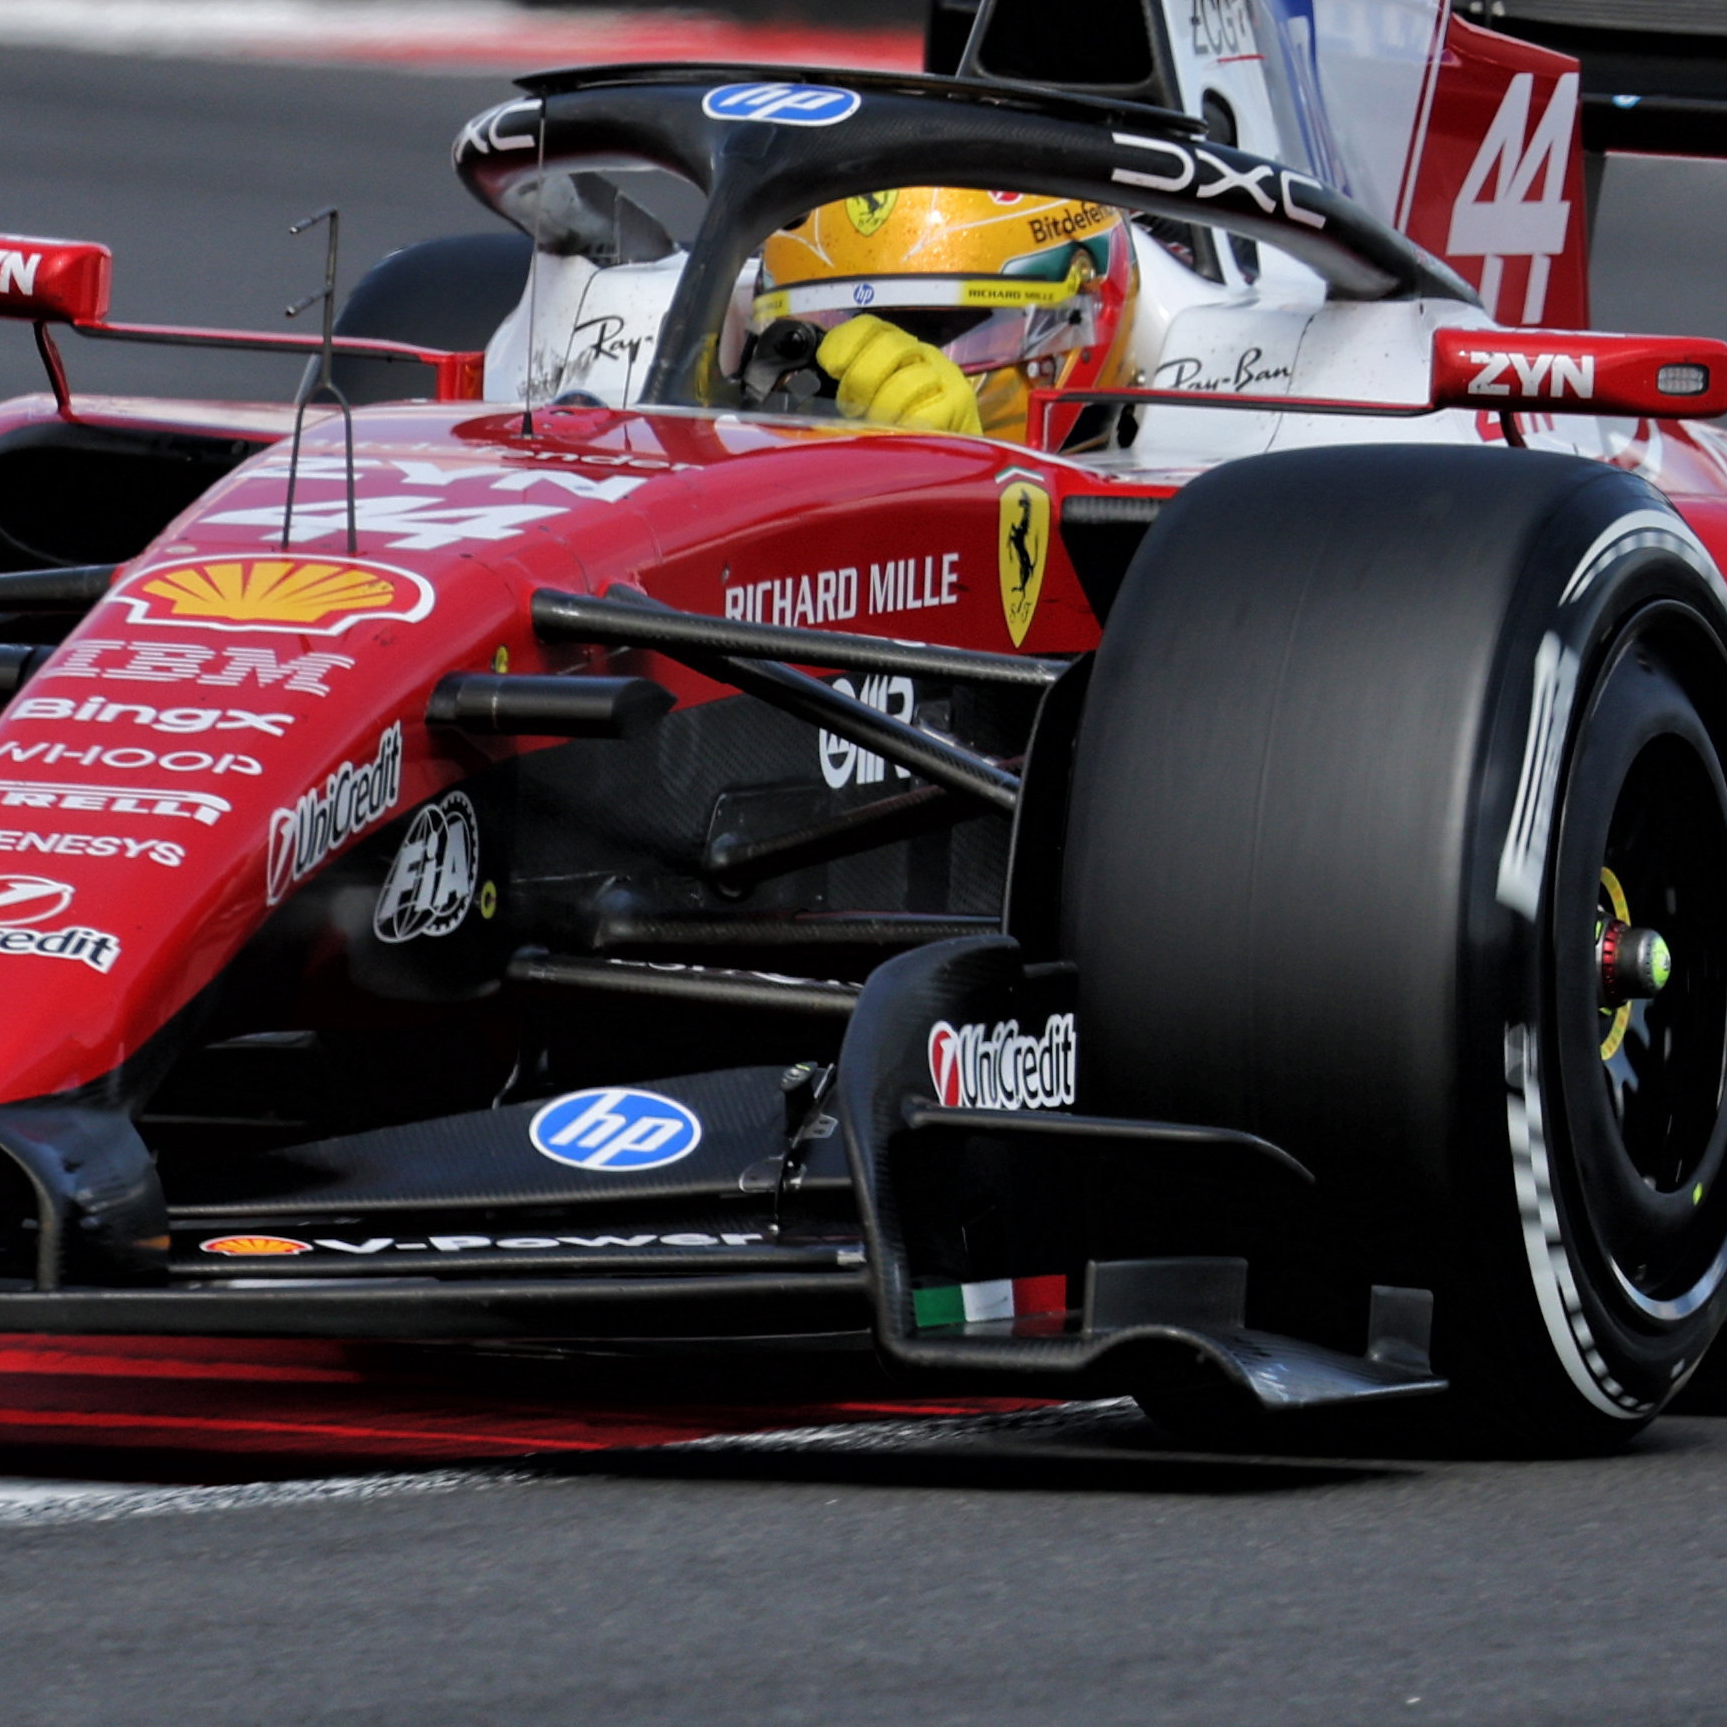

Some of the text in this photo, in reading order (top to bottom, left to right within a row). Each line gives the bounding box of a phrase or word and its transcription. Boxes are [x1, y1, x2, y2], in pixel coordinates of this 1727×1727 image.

[717, 83, 847, 121] hp
[1111, 132, 1327, 230] DXC
[1445, 72, 1580, 324] 44
[854, 283, 874, 305] hp
[968, 288, 1021, 300] RICHARD
[1467, 351, 1594, 399] ZYN
[237, 455, 654, 503] ZYN
[198, 495, 572, 551] 44
[725, 552, 960, 627] RICHARD MILLE
[40, 639, 355, 698] IBM
[294, 724, 402, 879] UniCredit
[960, 1017, 1074, 1109] UniCredit
[550, 1089, 685, 1168] hp
[313, 1230, 763, 1255] V-Power
